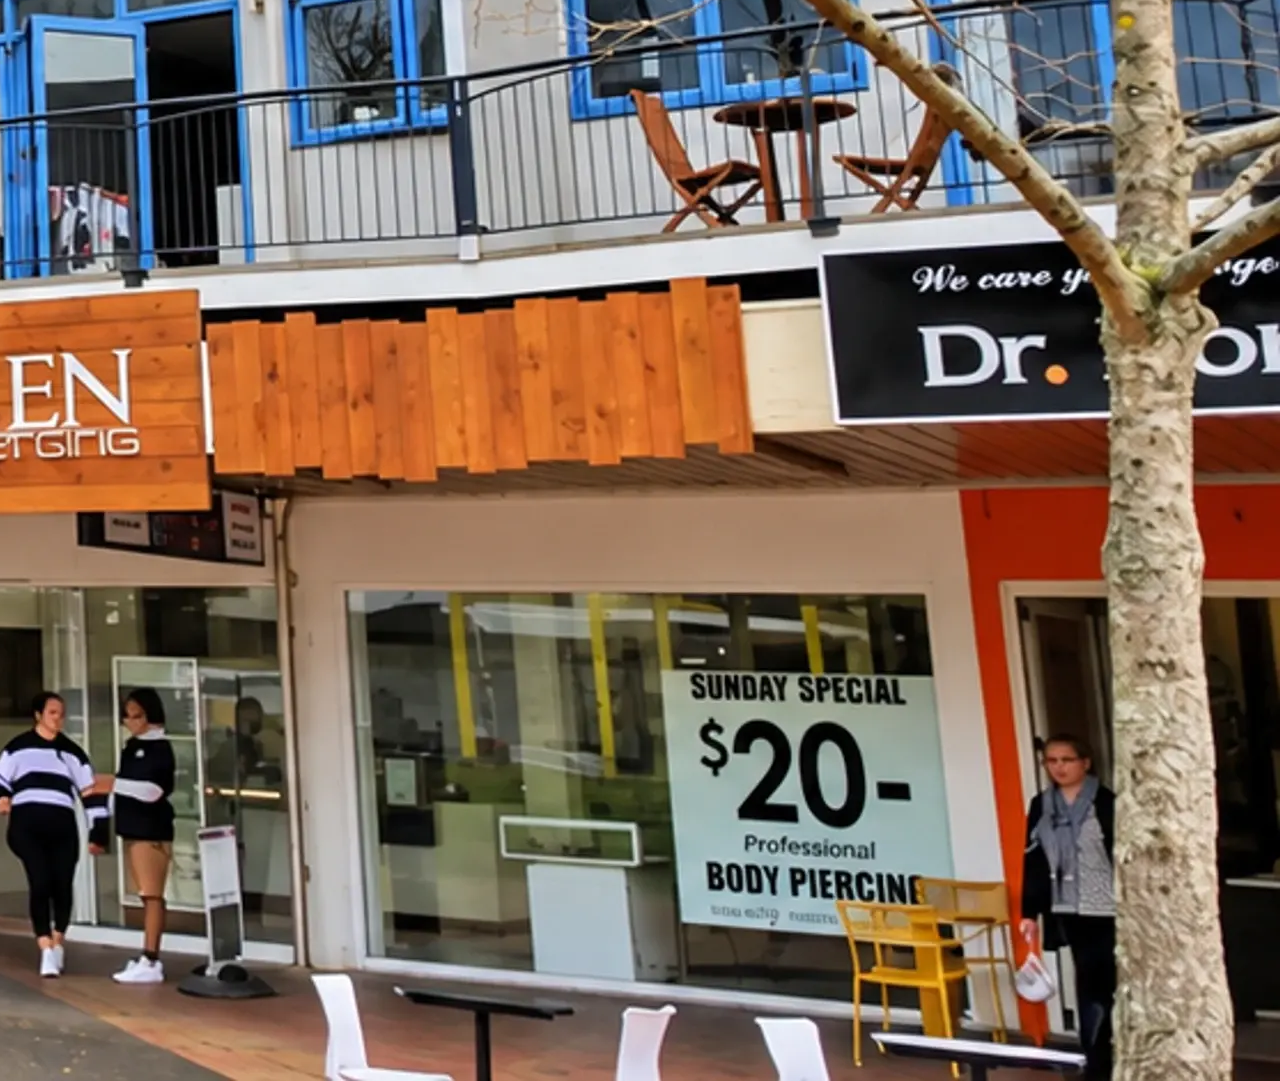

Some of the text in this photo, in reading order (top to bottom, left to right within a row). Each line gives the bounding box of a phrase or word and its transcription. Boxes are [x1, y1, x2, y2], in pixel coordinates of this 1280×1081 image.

[912, 264, 969, 293] We
[978, 269, 1053, 290] care
[918, 325, 1069, 387] Dr.
[690, 673, 907, 705] SUNDAY SPECIAL
[743, 834, 876, 860] Professional
[706, 861, 779, 897] BODY
